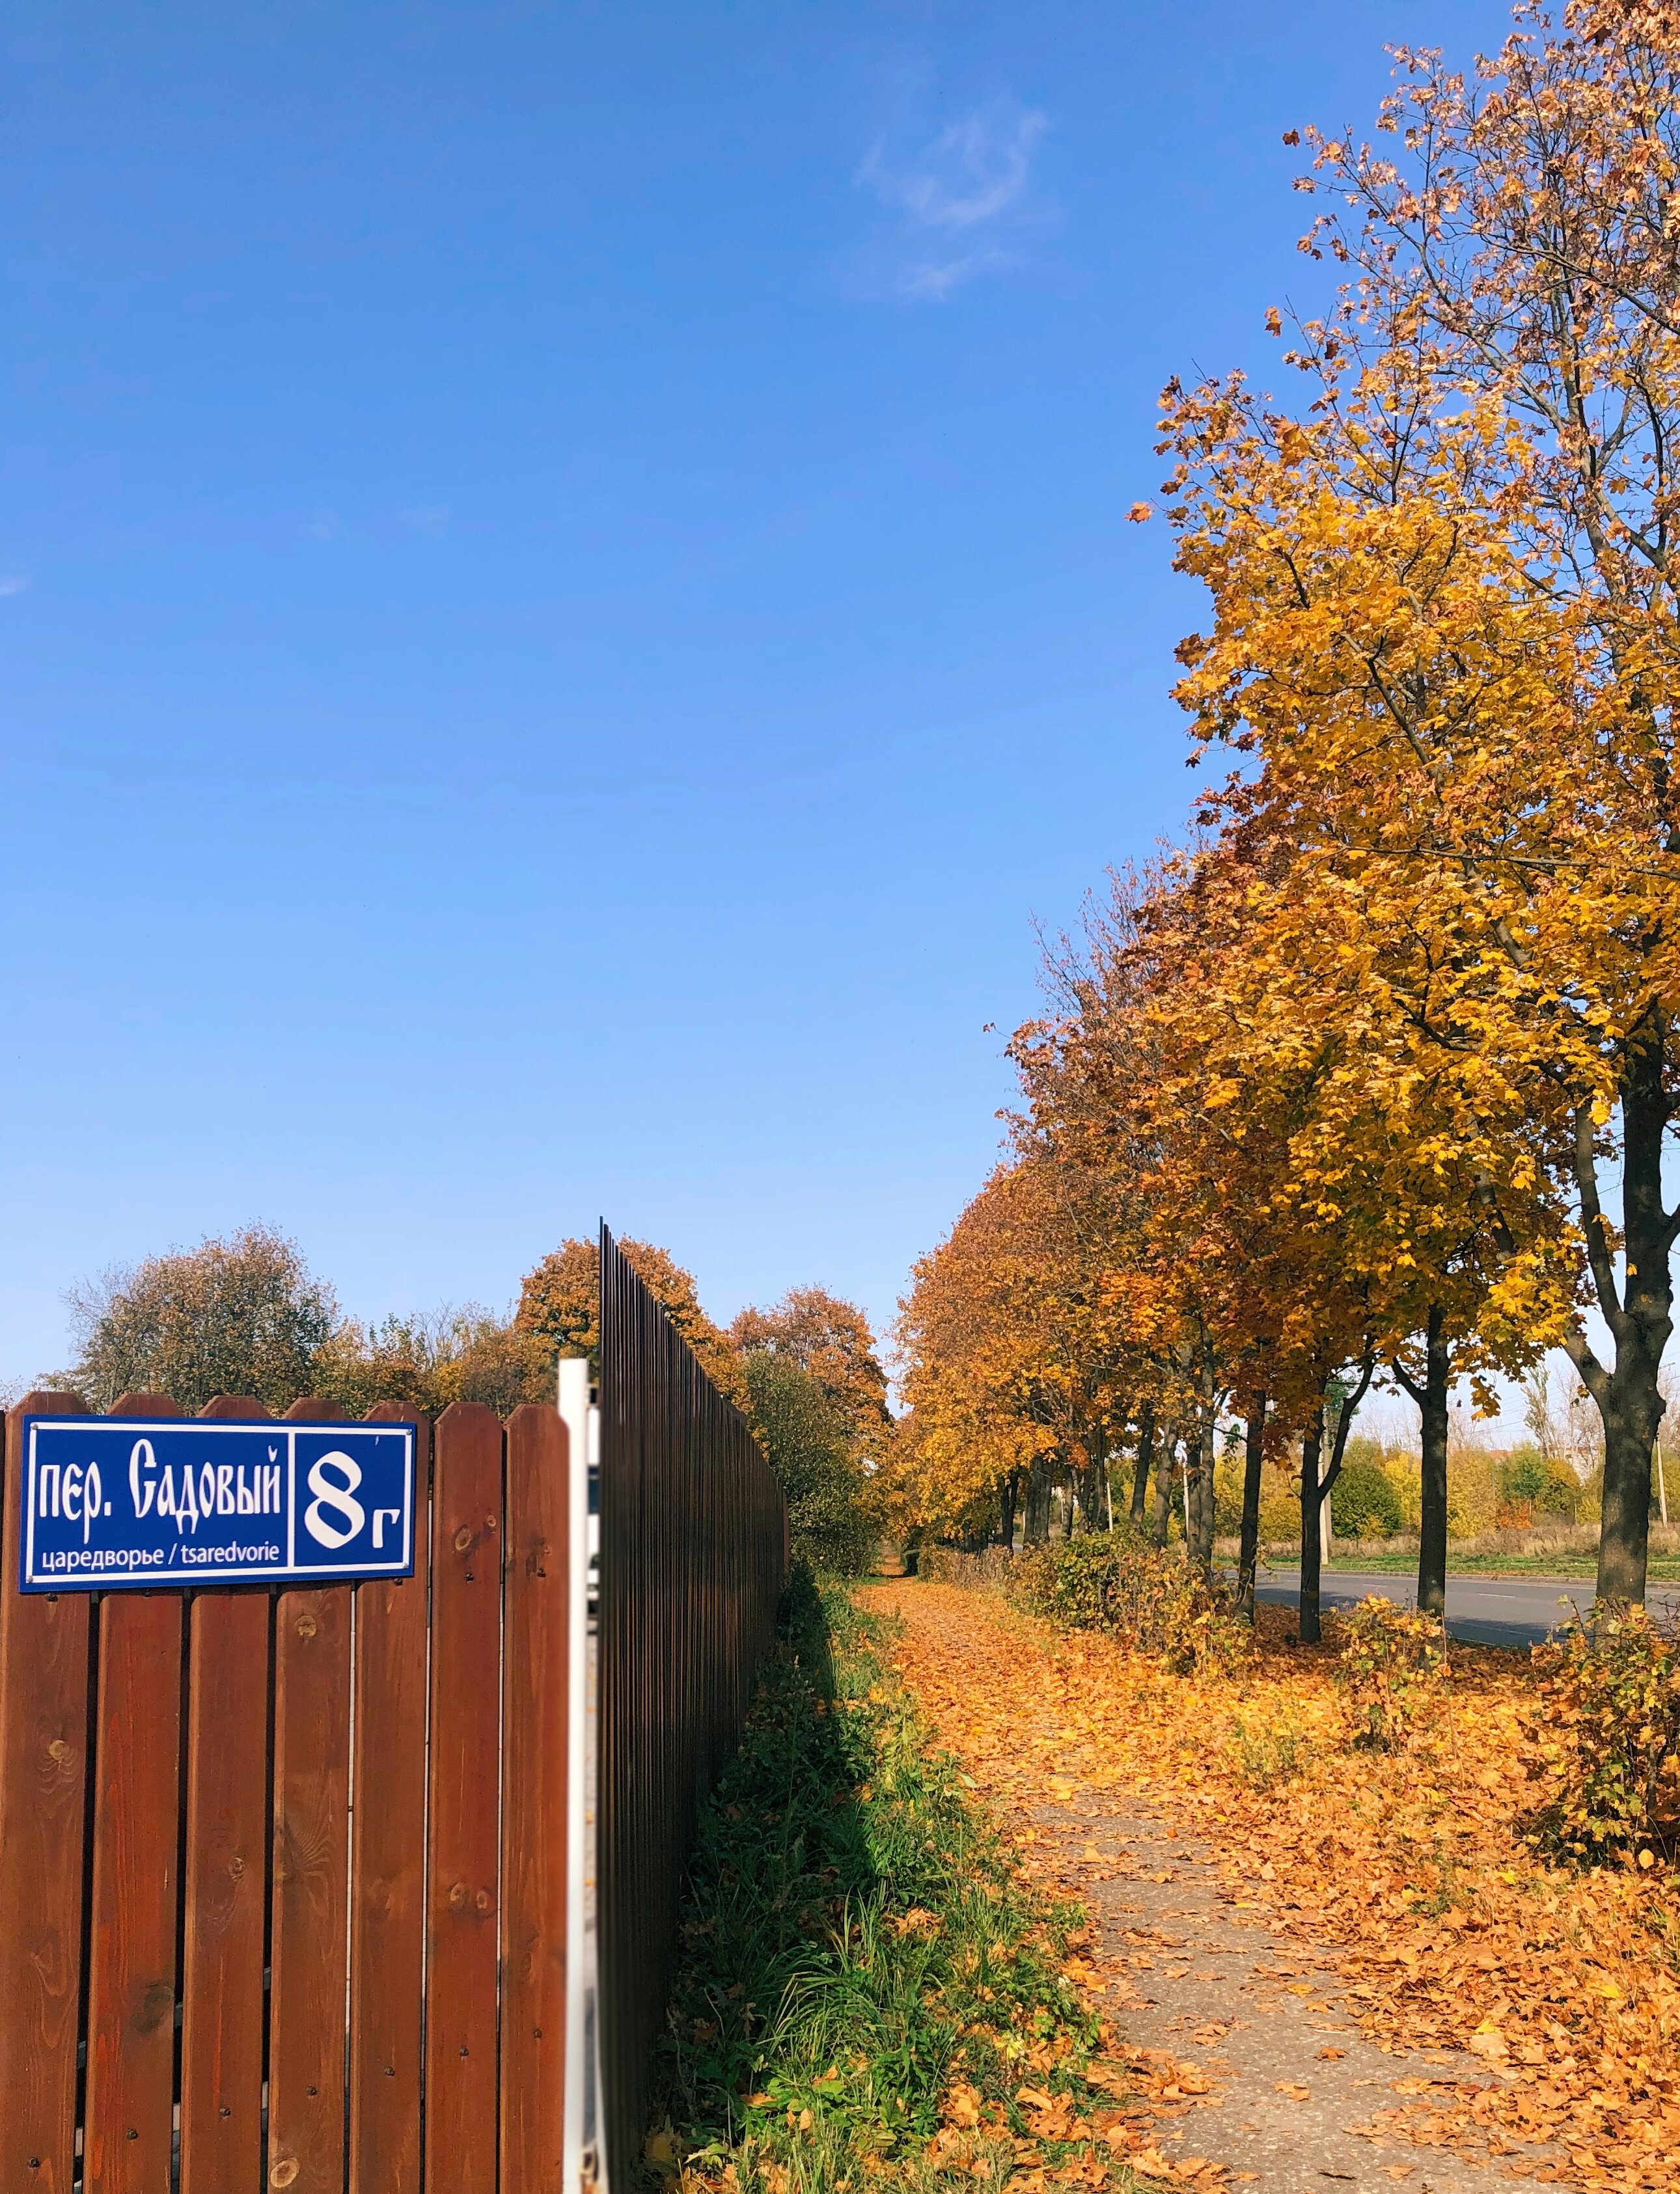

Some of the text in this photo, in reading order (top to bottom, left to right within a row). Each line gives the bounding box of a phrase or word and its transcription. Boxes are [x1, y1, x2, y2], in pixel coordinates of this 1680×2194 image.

[39, 1438, 281, 1544] пер. Садовый
[42, 1546, 164, 1572] царедворье
[180, 1540, 280, 1564] tsaredvorie
